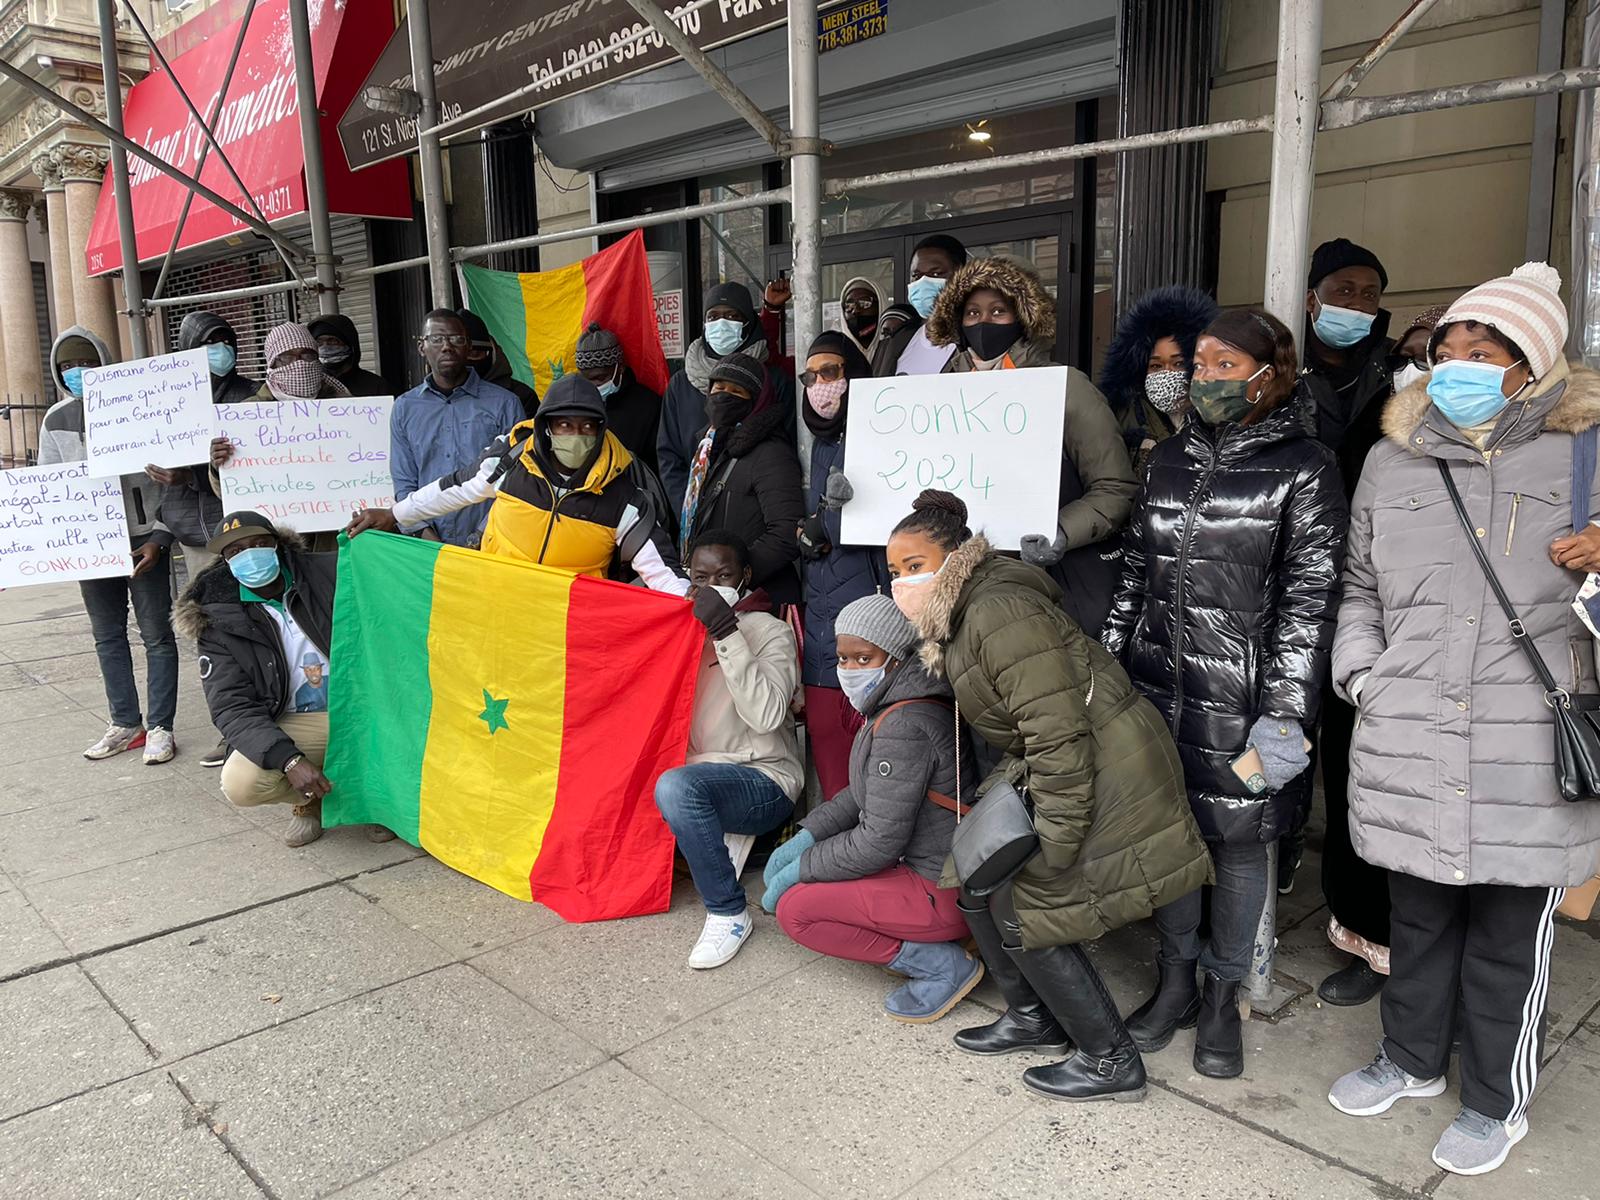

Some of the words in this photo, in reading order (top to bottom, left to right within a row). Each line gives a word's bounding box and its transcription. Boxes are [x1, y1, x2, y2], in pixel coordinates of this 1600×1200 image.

[496, 0, 584, 51] CENTER
[822, 10, 849, 31] MERY
[852, 0, 881, 21] STEEL
[817, 15, 888, 51] 718-381-3731
[362, 127, 380, 153] 121
[380, 123, 396, 148] St.
[441, 101, 462, 123] Ave
[653, 296, 679, 311] OPIES
[656, 313, 679, 325] ADE
[659, 329, 679, 341] ERE
[84, 368, 144, 386] Ousmane
[87, 389, 133, 412] l'homme
[171, 381, 192, 391] nous
[215, 401, 285, 424] Pastef
[294, 400, 322, 418] NY
[328, 404, 384, 424] exige
[89, 420, 112, 440] pour
[116, 416, 130, 424] un
[151, 429, 163, 445] et
[258, 423, 351, 447] libération
[348, 444, 387, 462] des
[224, 474, 315, 496] Patriotes
[877, 450, 995, 500] 2024
[0, 484, 49, 514] négal
[66, 485, 88, 501] La
[255, 501, 334, 520] JUSTICE
[0, 512, 43, 528] artout
[52, 512, 98, 525] mais
[105, 505, 126, 520] la
[0, 541, 34, 556] ustice
[47, 528, 88, 549] nulle
[96, 524, 125, 550] part
[19, 557, 88, 575] SONKO
[92, 554, 125, 567] 2024
